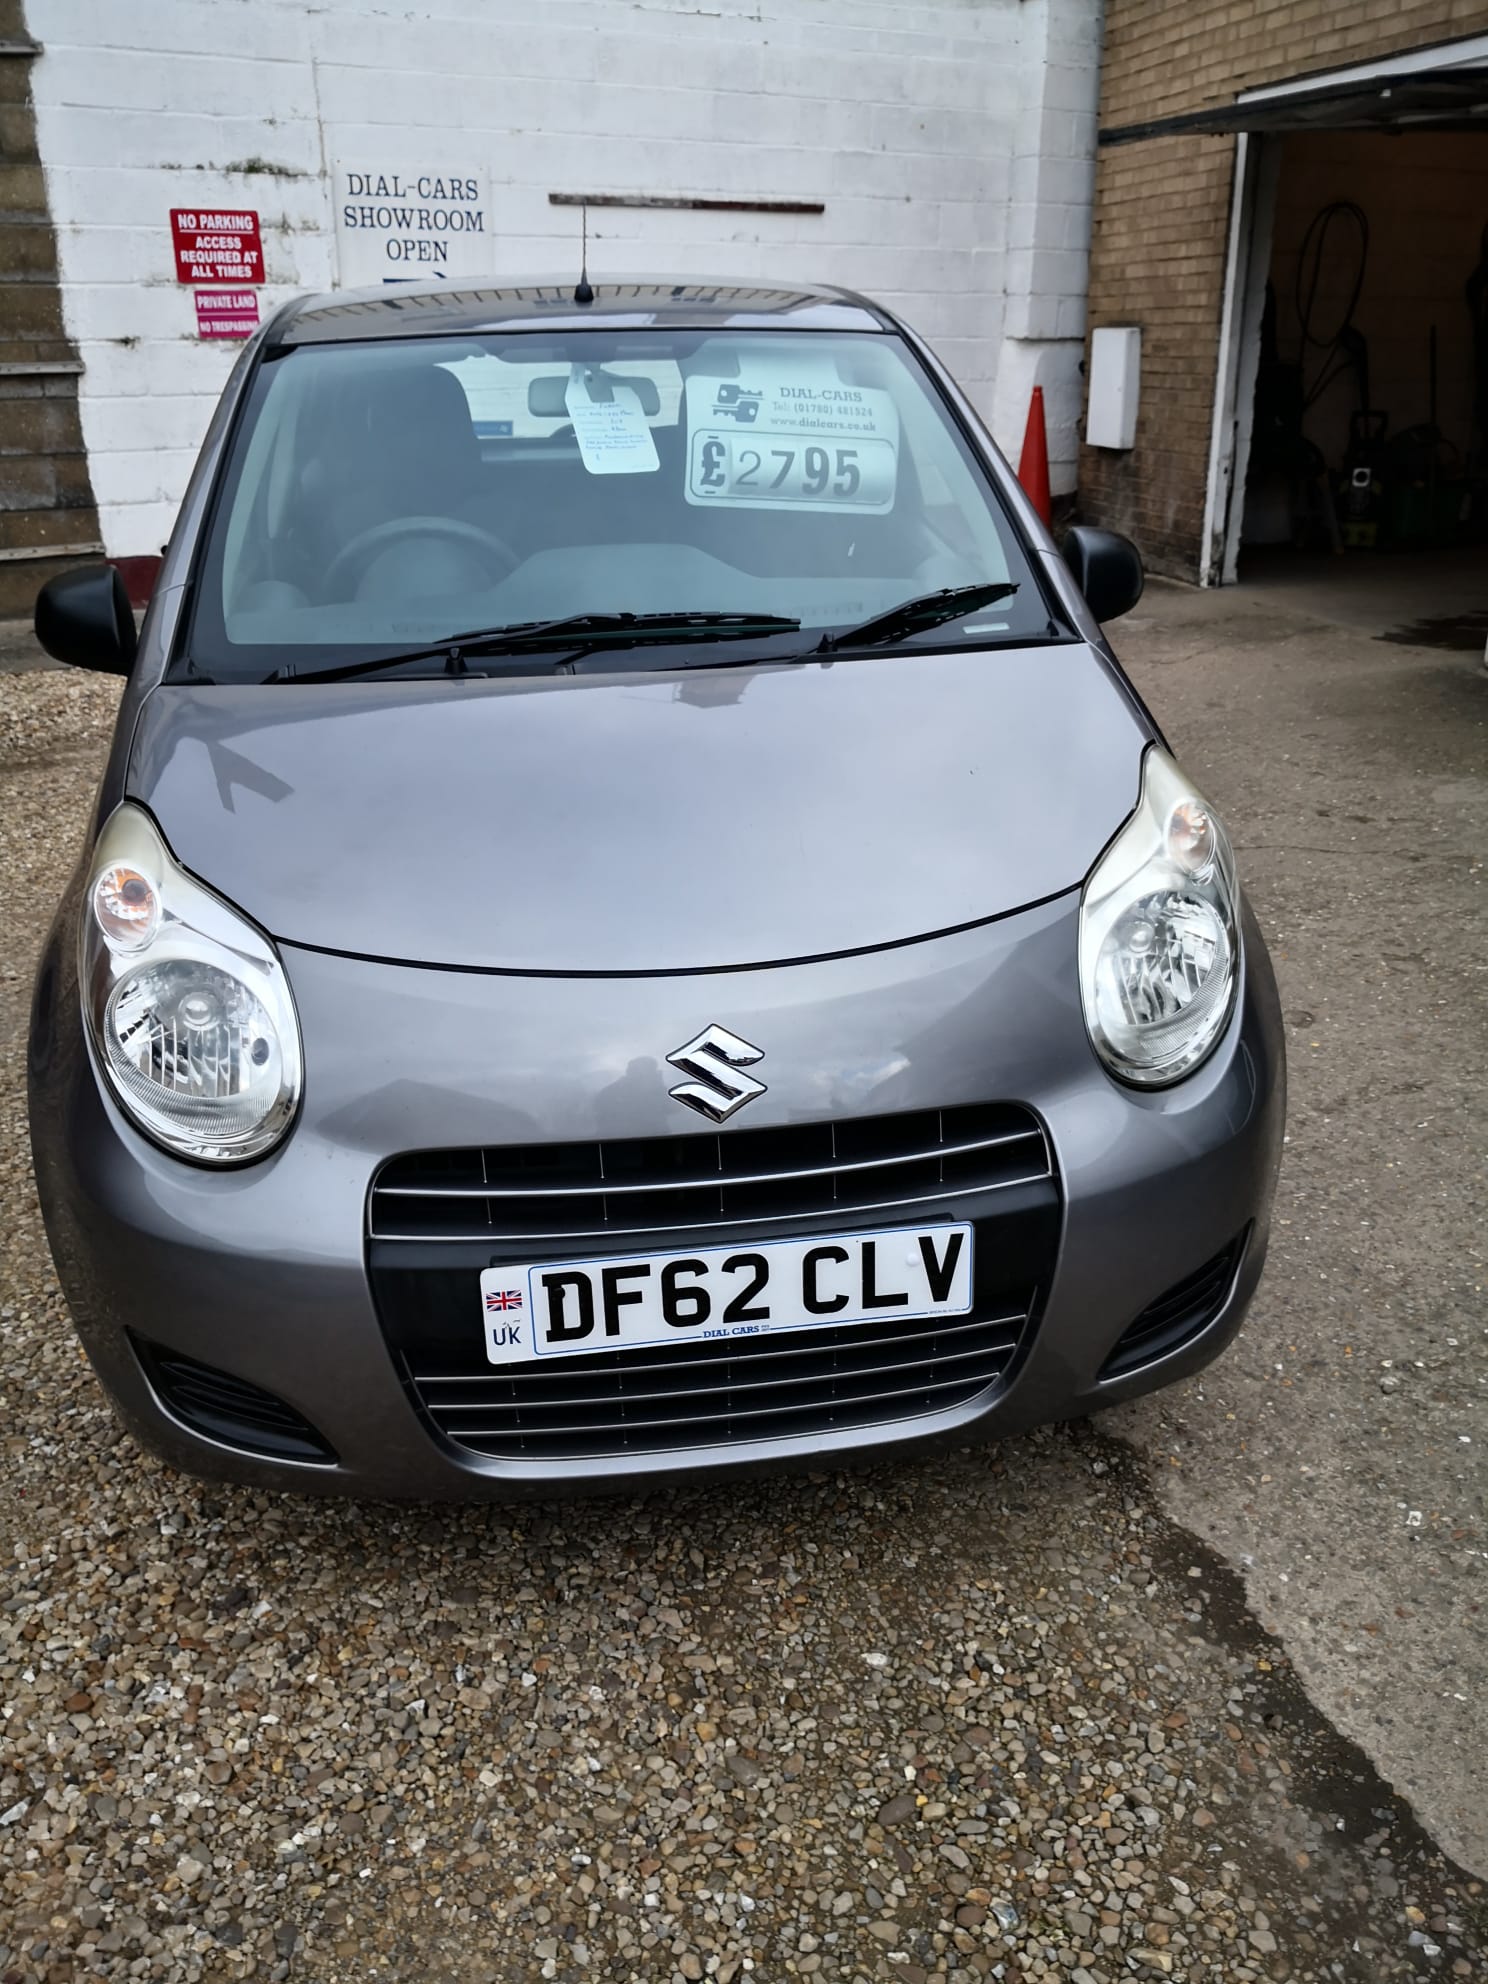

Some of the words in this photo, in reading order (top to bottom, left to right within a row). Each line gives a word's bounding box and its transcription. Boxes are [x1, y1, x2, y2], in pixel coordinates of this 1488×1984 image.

[346, 173, 479, 201] DIAL-CARS
[178, 214, 197, 229] NO
[199, 214, 254, 231] PARKING
[343, 205, 485, 232] SHOWROOM
[195, 236, 242, 249] ACCESS
[386, 238, 449, 262] OPEN
[180, 250, 242, 263] REQUIRED
[243, 251, 258, 264] AT
[191, 265, 214, 278] ALL
[215, 265, 253, 278] TIMES
[197, 295, 232, 309] PRIVATE
[232, 295, 256, 308] LAND
[200, 321, 211, 332] NO
[780, 386, 863, 403] DIAL-CARS
[770, 417, 876, 432] www.dialcars.co.uk
[700, 440, 861, 497] £2795
[541, 1253, 770, 1343] DF62
[802, 1233, 965, 1315] CLV
[493, 1325, 521, 1346] UK
[703, 1329, 730, 1338] DIAL
[731, 1325, 760, 1335] CARS
